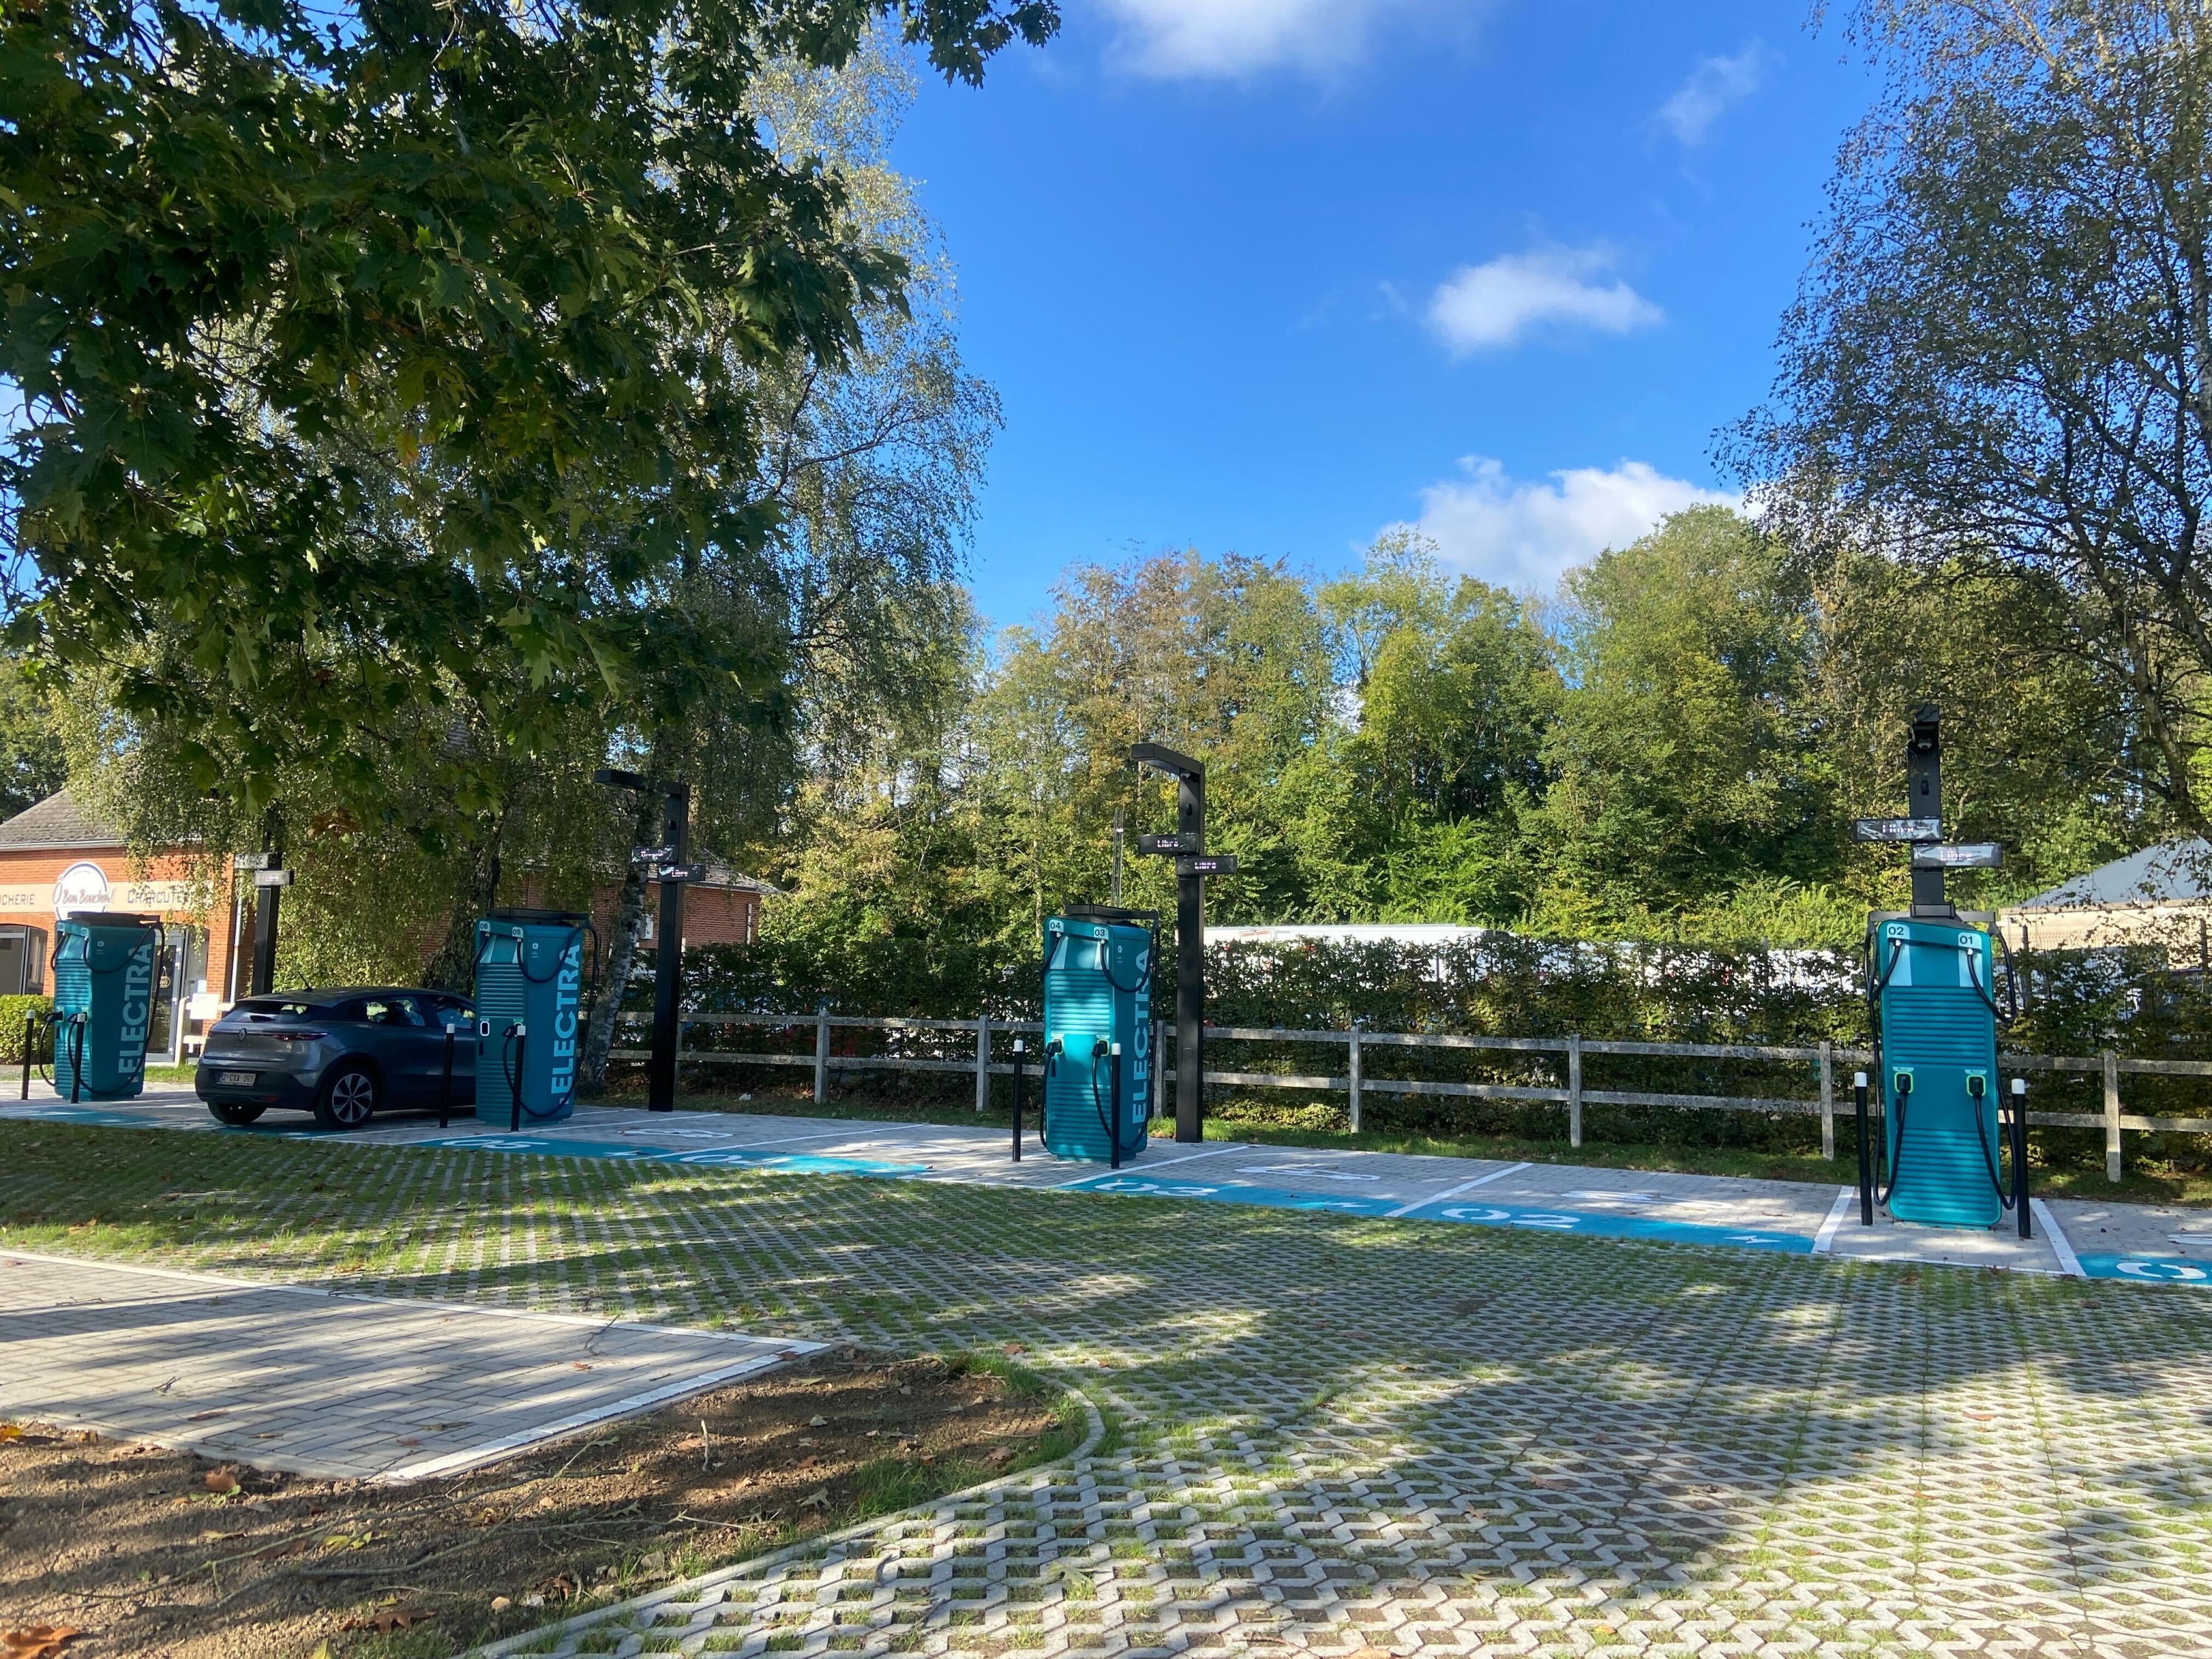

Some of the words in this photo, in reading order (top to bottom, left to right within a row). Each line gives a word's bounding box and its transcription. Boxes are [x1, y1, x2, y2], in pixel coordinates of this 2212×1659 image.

[1157, 839, 1179, 848] Libre
[1940, 850, 1972, 861] Libre
[1050, 922, 1061, 930] 04
[1888, 926, 1905, 936] 02
[1959, 935, 1973, 945] 01
[118, 943, 152, 1074] ELECTRA
[551, 944, 580, 1094] ELECTRA
[1133, 948, 1149, 1124] ELECTRA
[441, 1139, 550, 1150] 05
[1094, 1182, 1219, 1197] 03
[1441, 1207, 1582, 1228] 02
